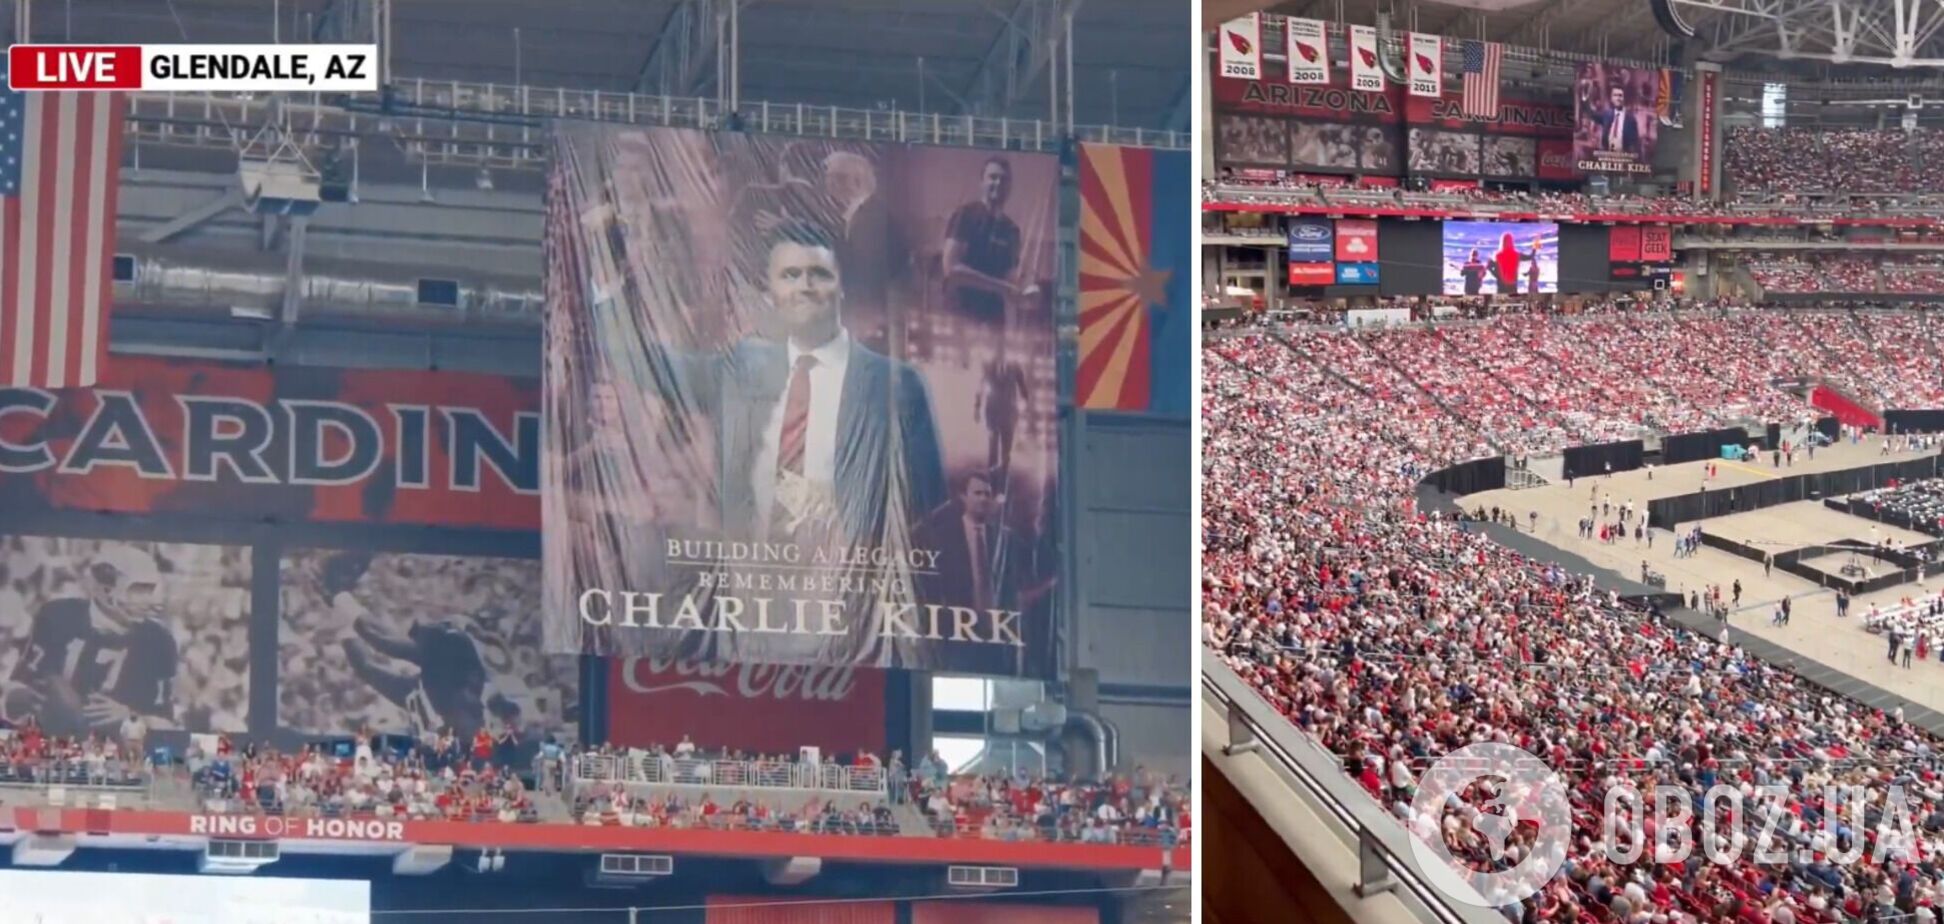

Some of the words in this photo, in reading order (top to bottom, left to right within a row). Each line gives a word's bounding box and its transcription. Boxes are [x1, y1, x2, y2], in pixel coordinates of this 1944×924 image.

[1226, 65, 1255, 75] 2008
[1295, 71, 1324, 81] 2008
[1243, 83, 1393, 115] ARIZONA
[1414, 83, 1436, 93] 2015
[1578, 160, 1625, 171] CHARLIE
[667, 539, 800, 563] BUILDING
[812, 547, 833, 565] A
[839, 547, 941, 569] LEGACY
[699, 571, 906, 595] REMEMBERING
[579, 588, 849, 636] CHARLIE
[879, 603, 1025, 647] KIRK
[191, 816, 256, 837] RING
[265, 817, 298, 837] OF
[306, 818, 404, 841] HONOR
